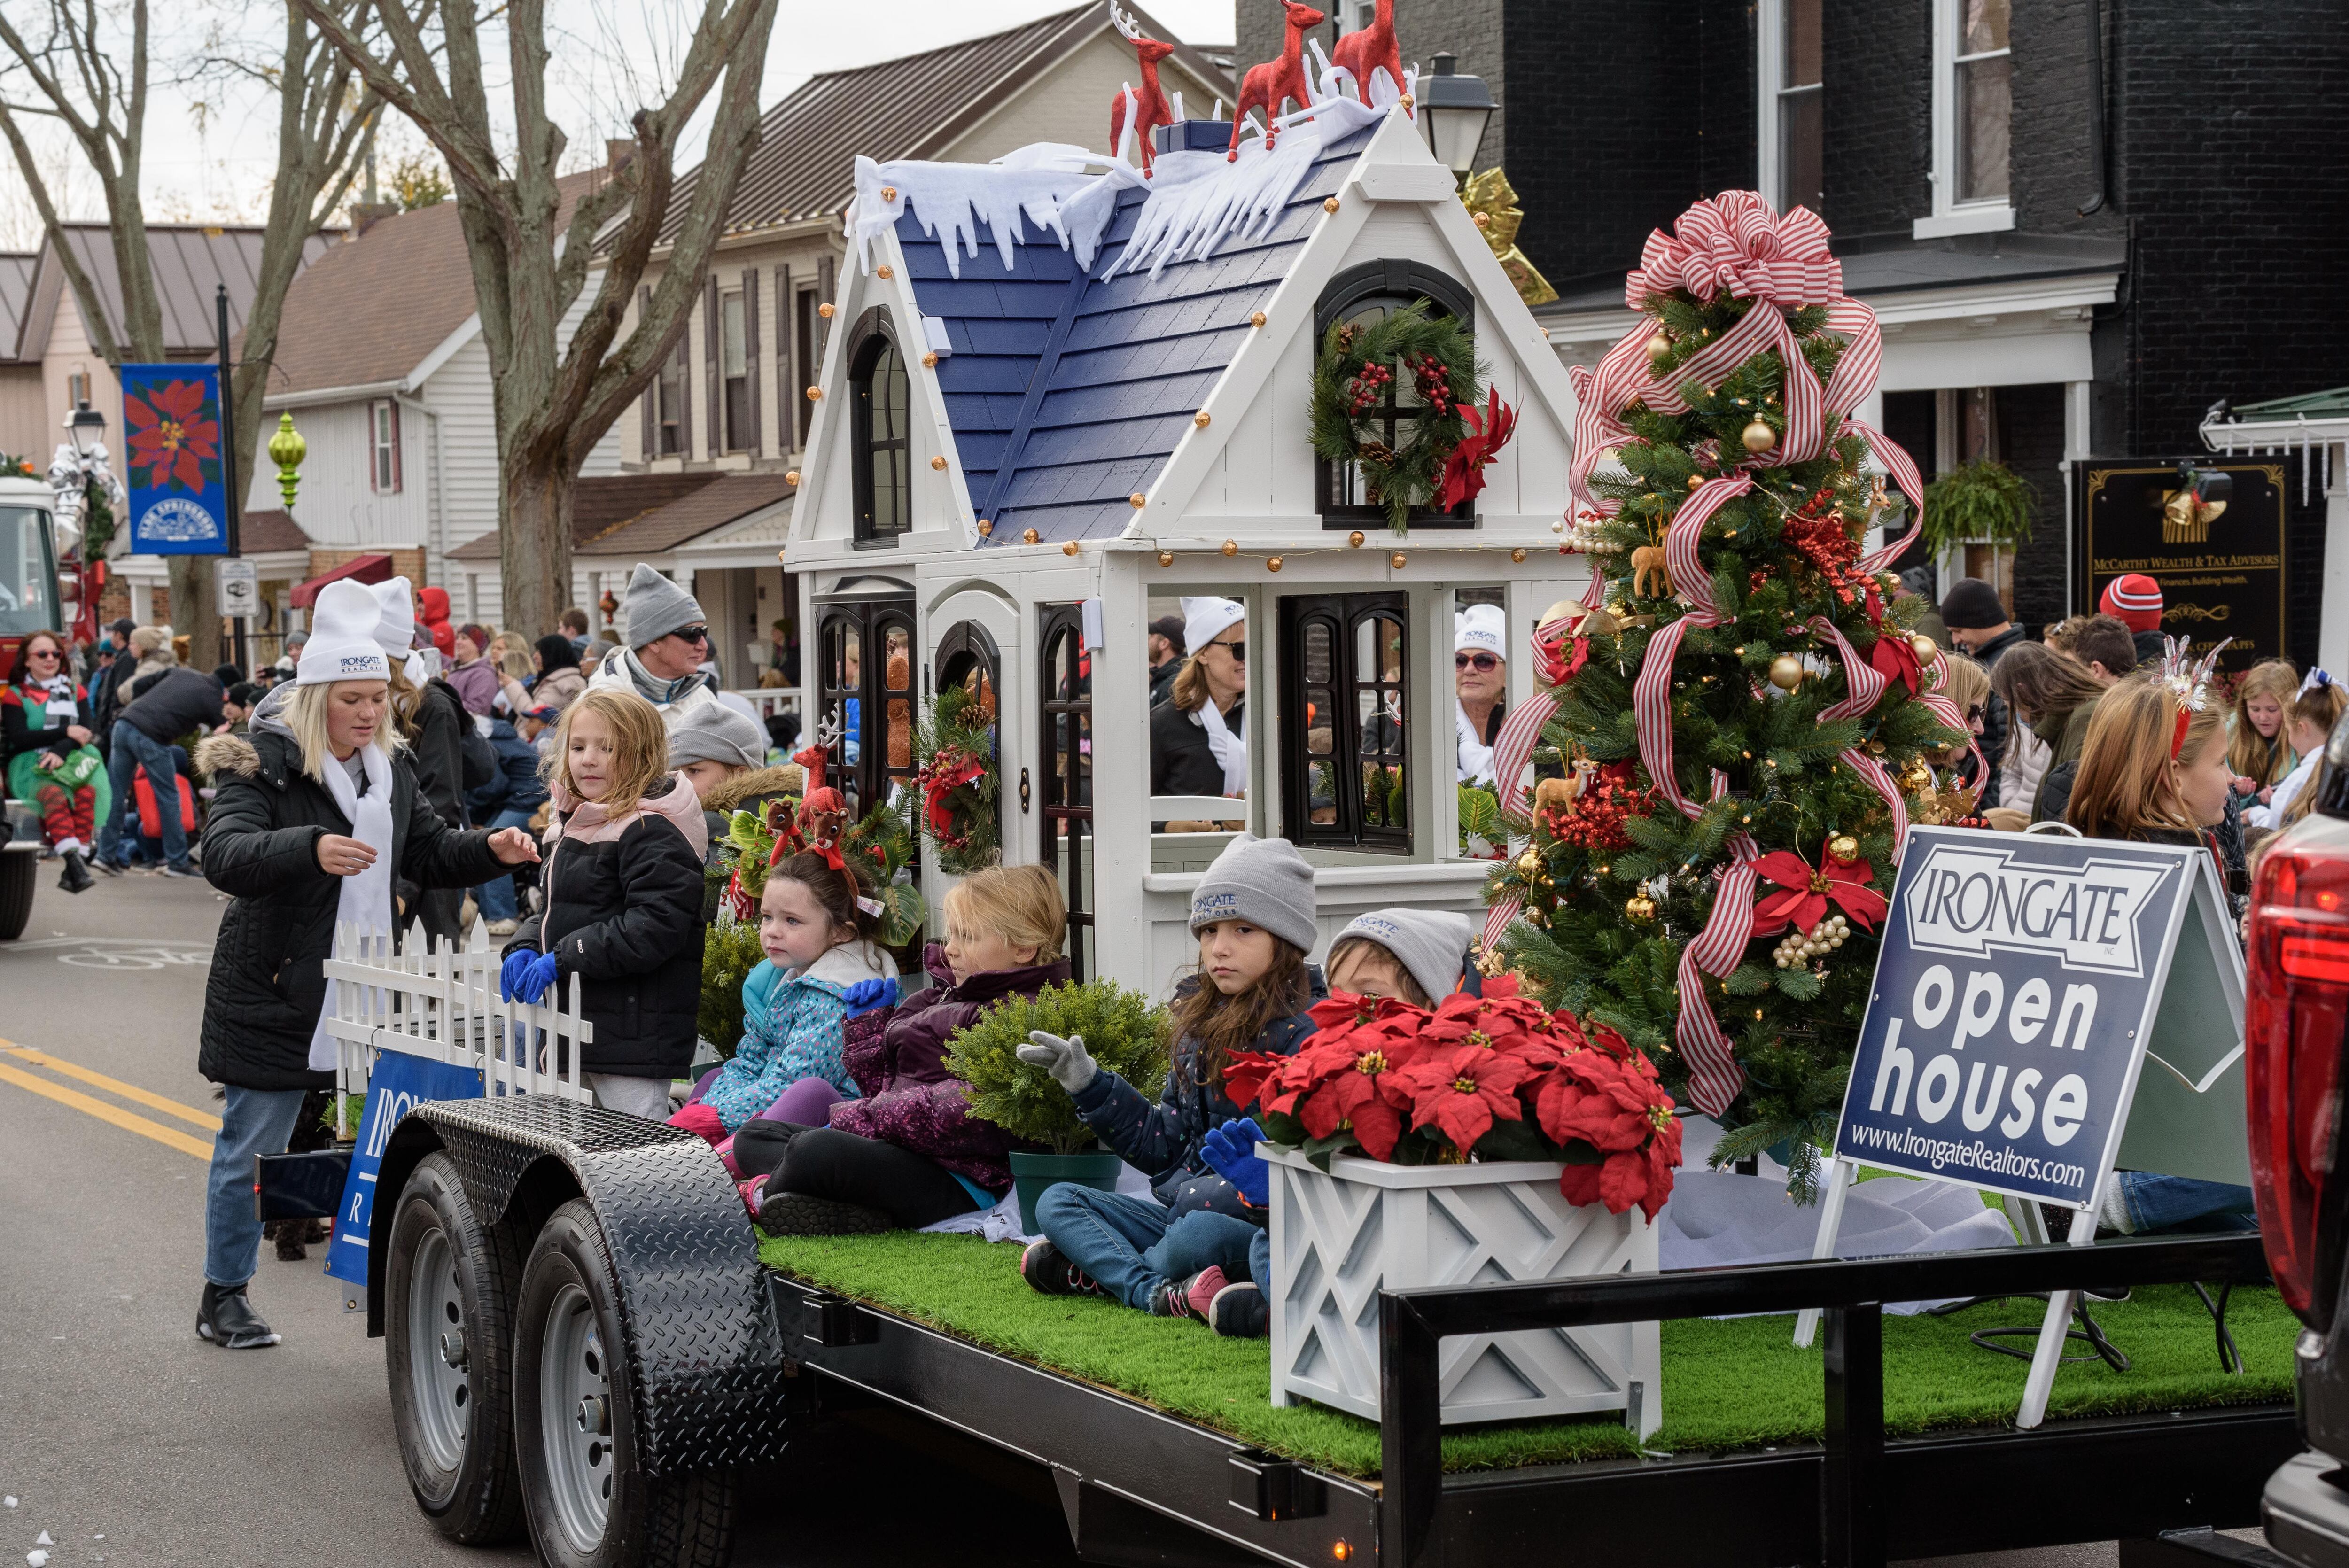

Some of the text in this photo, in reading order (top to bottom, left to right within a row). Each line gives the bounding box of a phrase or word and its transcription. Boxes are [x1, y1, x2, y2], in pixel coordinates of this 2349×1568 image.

[2150, 556, 2193, 569] WEALTH
[2195, 556, 2204, 567] &
[2205, 555, 2227, 567] TAX
[2229, 554, 2279, 566] ADVISORS
[341, 656, 381, 666] IRONGATE
[1918, 869, 2129, 945] IRONGATE
[1912, 964, 2098, 1051] open
[1869, 1017, 2088, 1146] house
[1852, 1124, 2085, 1188] www.IrongateRealtors.com
